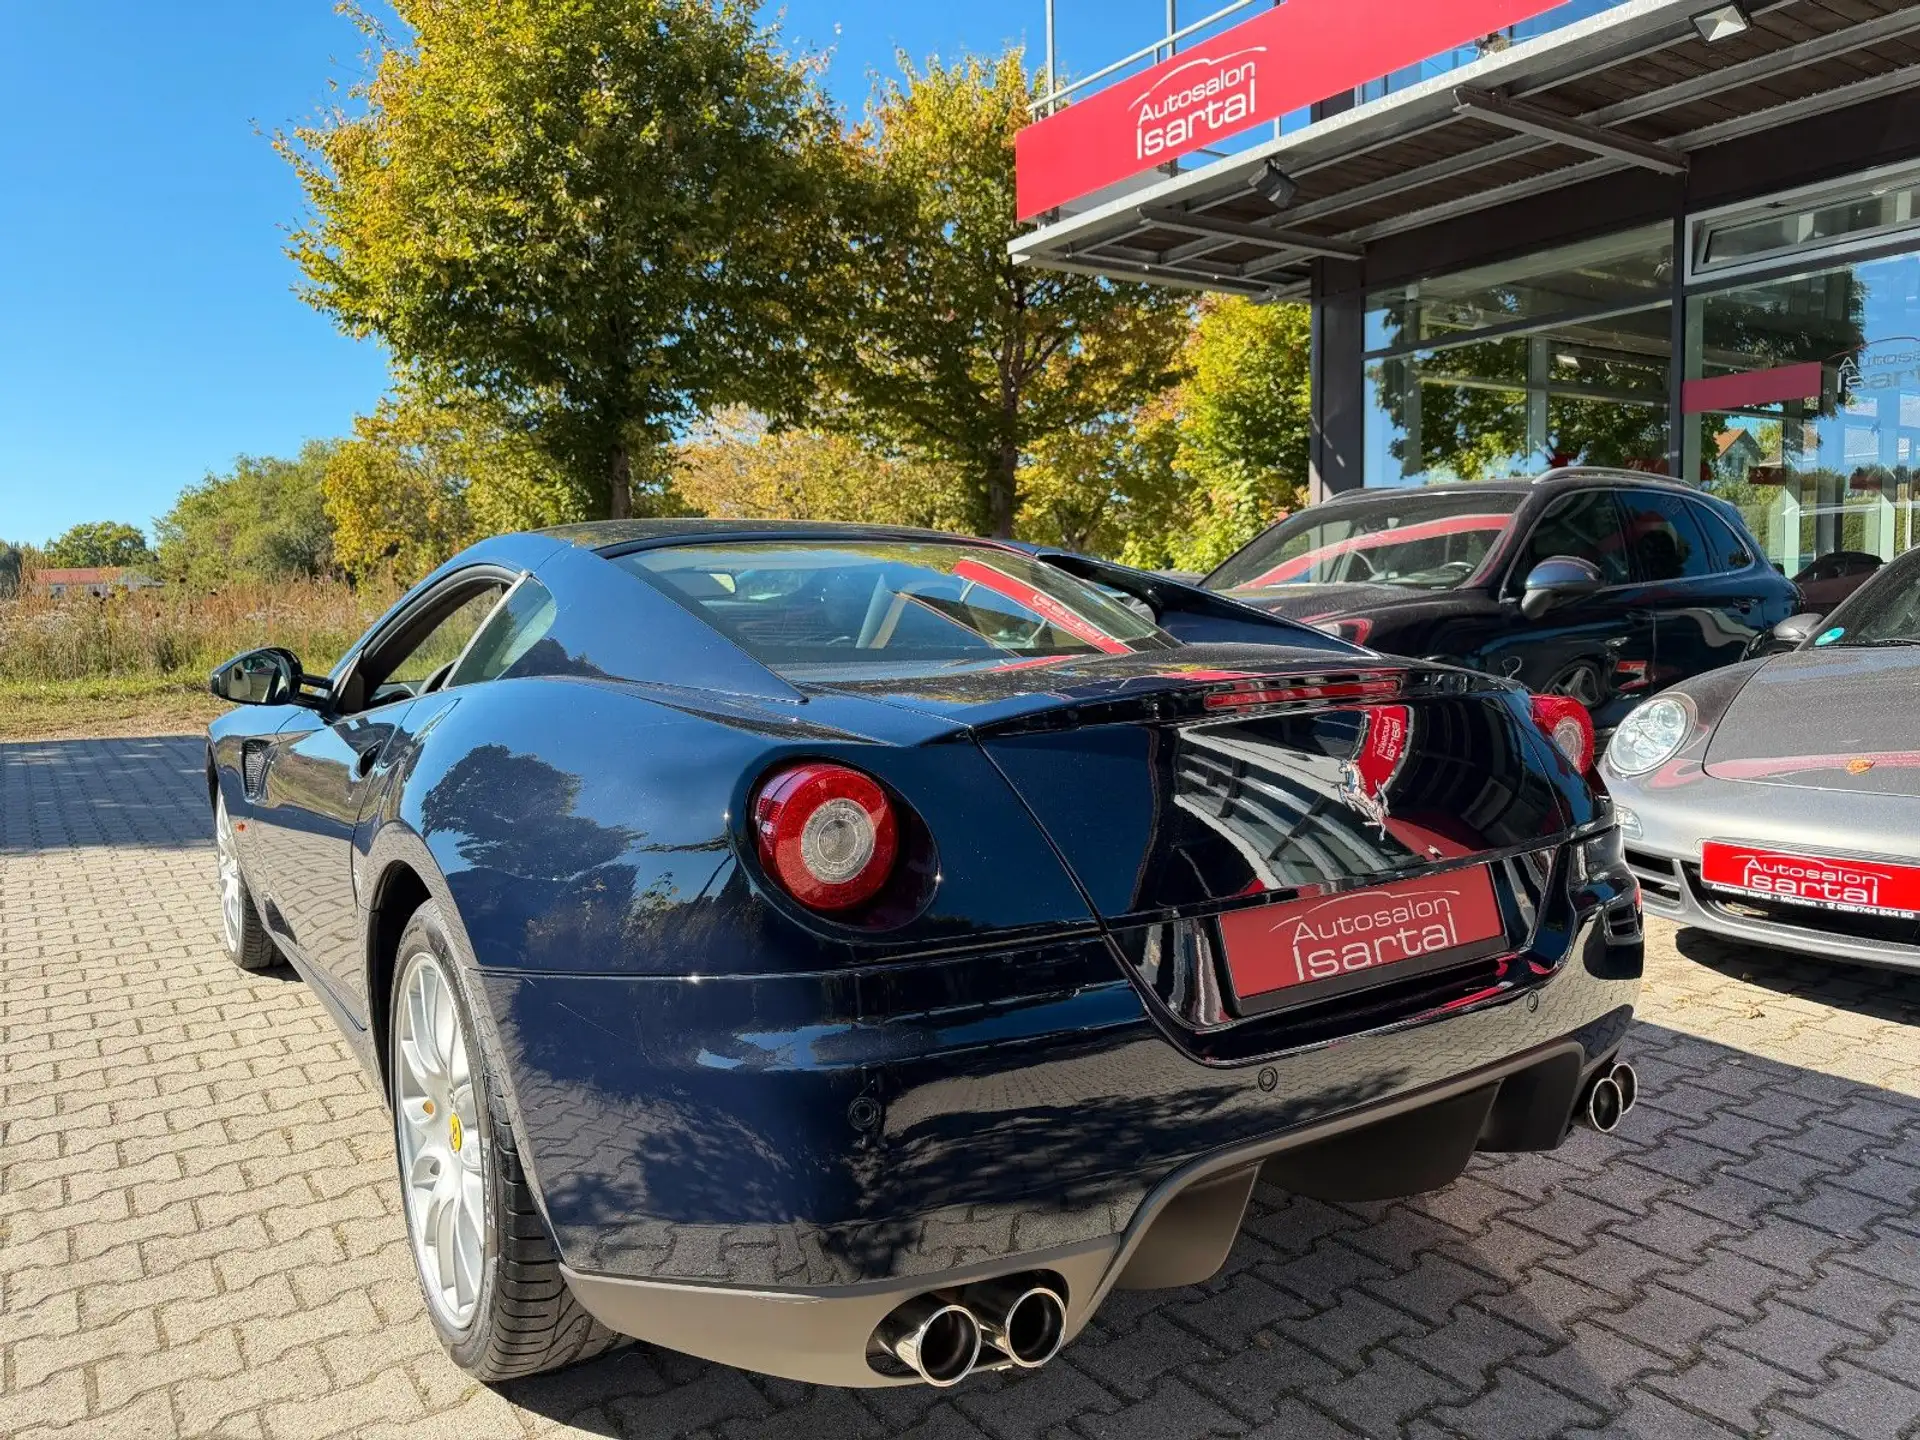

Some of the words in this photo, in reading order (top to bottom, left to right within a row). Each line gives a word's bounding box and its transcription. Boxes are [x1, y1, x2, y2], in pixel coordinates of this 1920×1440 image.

[1137, 61, 1255, 126] Autosalon
[1137, 78, 1255, 159] Isartal
[1744, 867, 1878, 905] Isartal
[1746, 859, 1878, 886] Autosalon
[1292, 913, 1458, 981] Isartal
[1293, 898, 1451, 945] Autosalon
